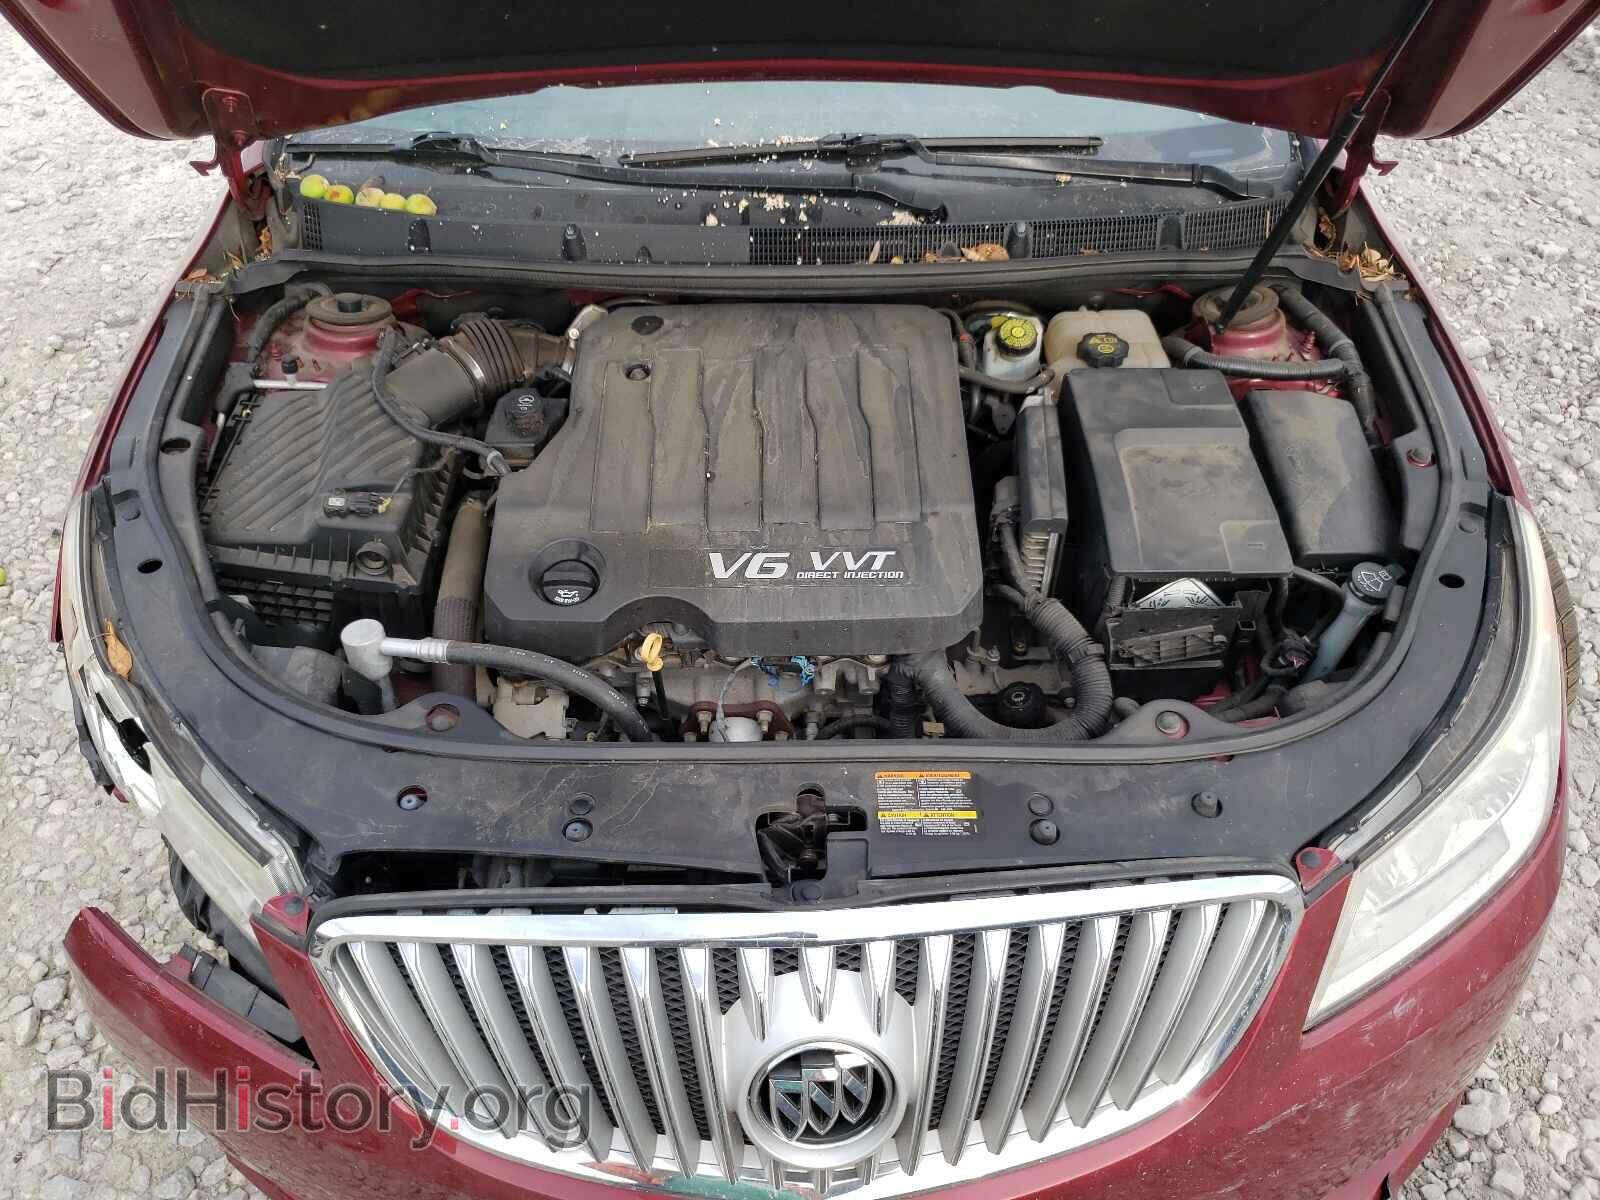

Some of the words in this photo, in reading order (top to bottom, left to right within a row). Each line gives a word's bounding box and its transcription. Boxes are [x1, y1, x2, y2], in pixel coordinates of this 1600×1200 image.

[708, 551, 791, 579] V6
[809, 551, 897, 571] VVT
[796, 571, 840, 579] DIRECT
[843, 571, 905, 579] INJECTION
